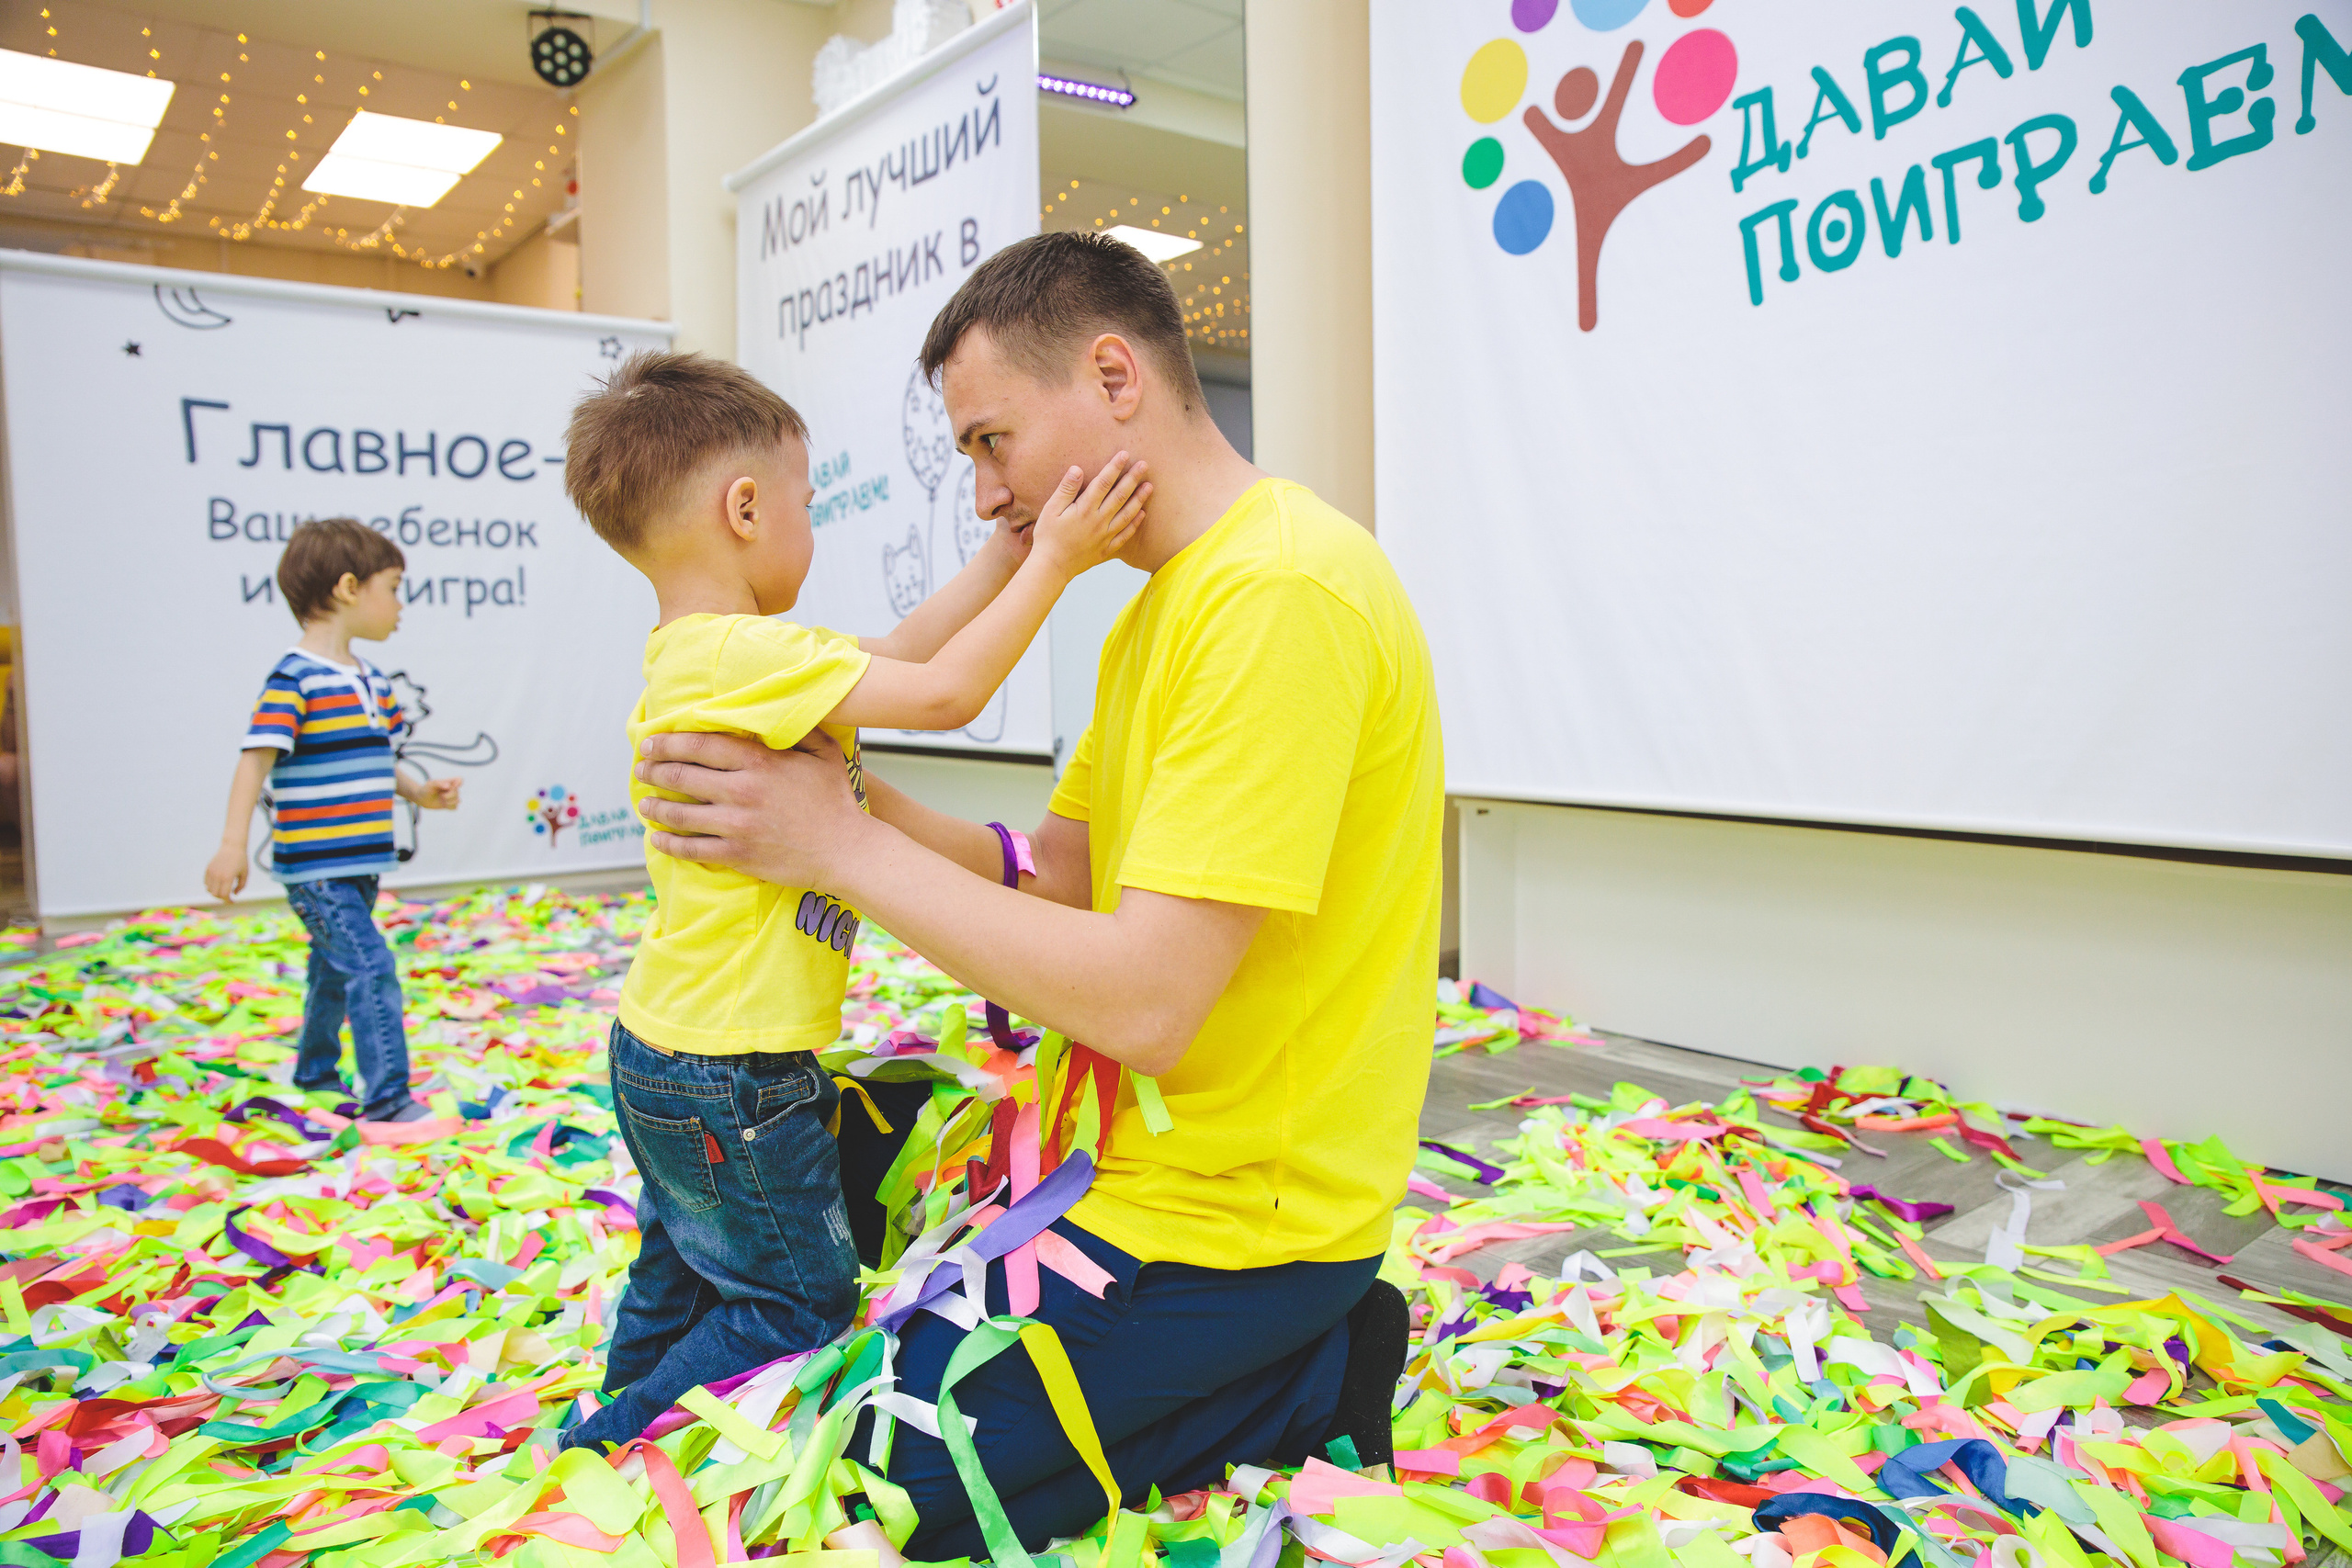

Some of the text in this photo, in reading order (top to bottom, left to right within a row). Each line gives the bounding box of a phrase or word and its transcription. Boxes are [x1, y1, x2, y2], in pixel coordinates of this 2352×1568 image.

[761, 73, 1000, 262] Мой лучший
[779, 218, 980, 352] праздник в
[809, 449, 851, 489] АВАЙ
[354, 505, 537, 548] ебенок
[808, 474, 889, 528] ОИГРАЕМ!
[242, 565, 526, 617] и игра!
